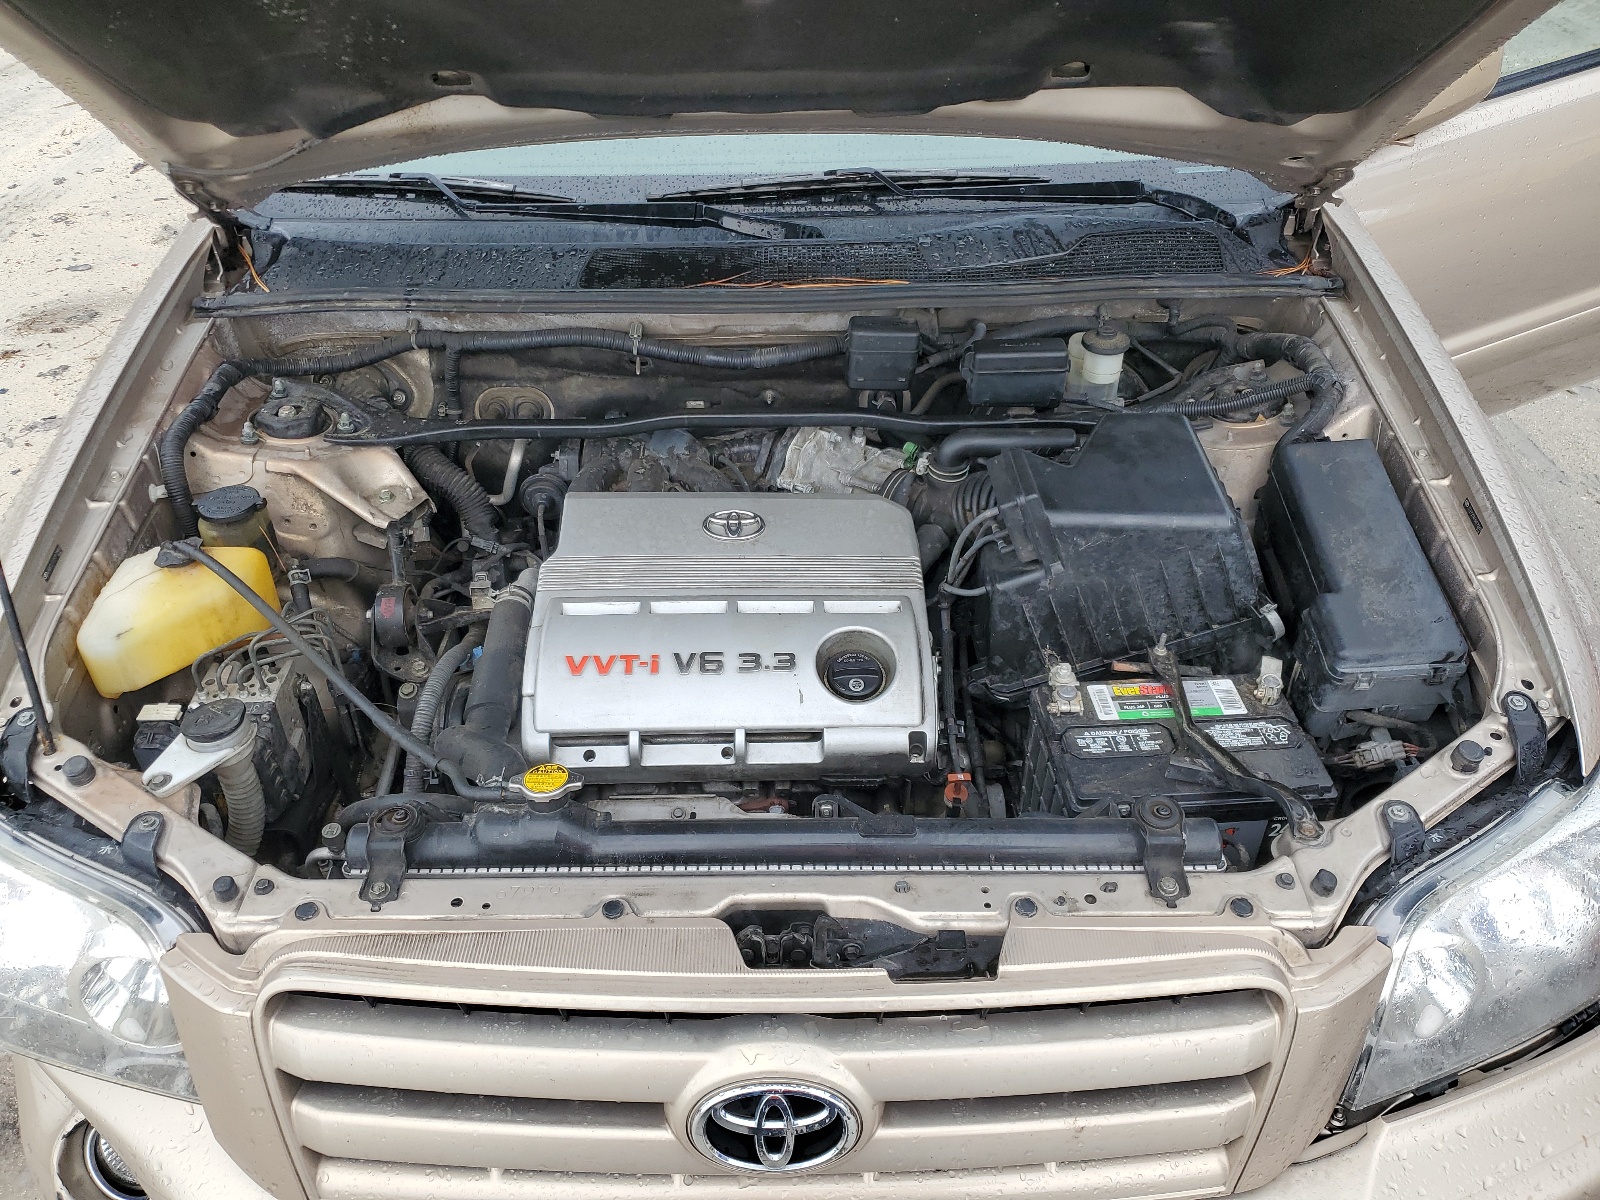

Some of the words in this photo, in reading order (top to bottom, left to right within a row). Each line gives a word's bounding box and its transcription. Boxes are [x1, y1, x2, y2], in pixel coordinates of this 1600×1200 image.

[565, 653, 661, 677] VVT-i
[672, 651, 726, 676] V6
[737, 651, 798, 674] 3.3
